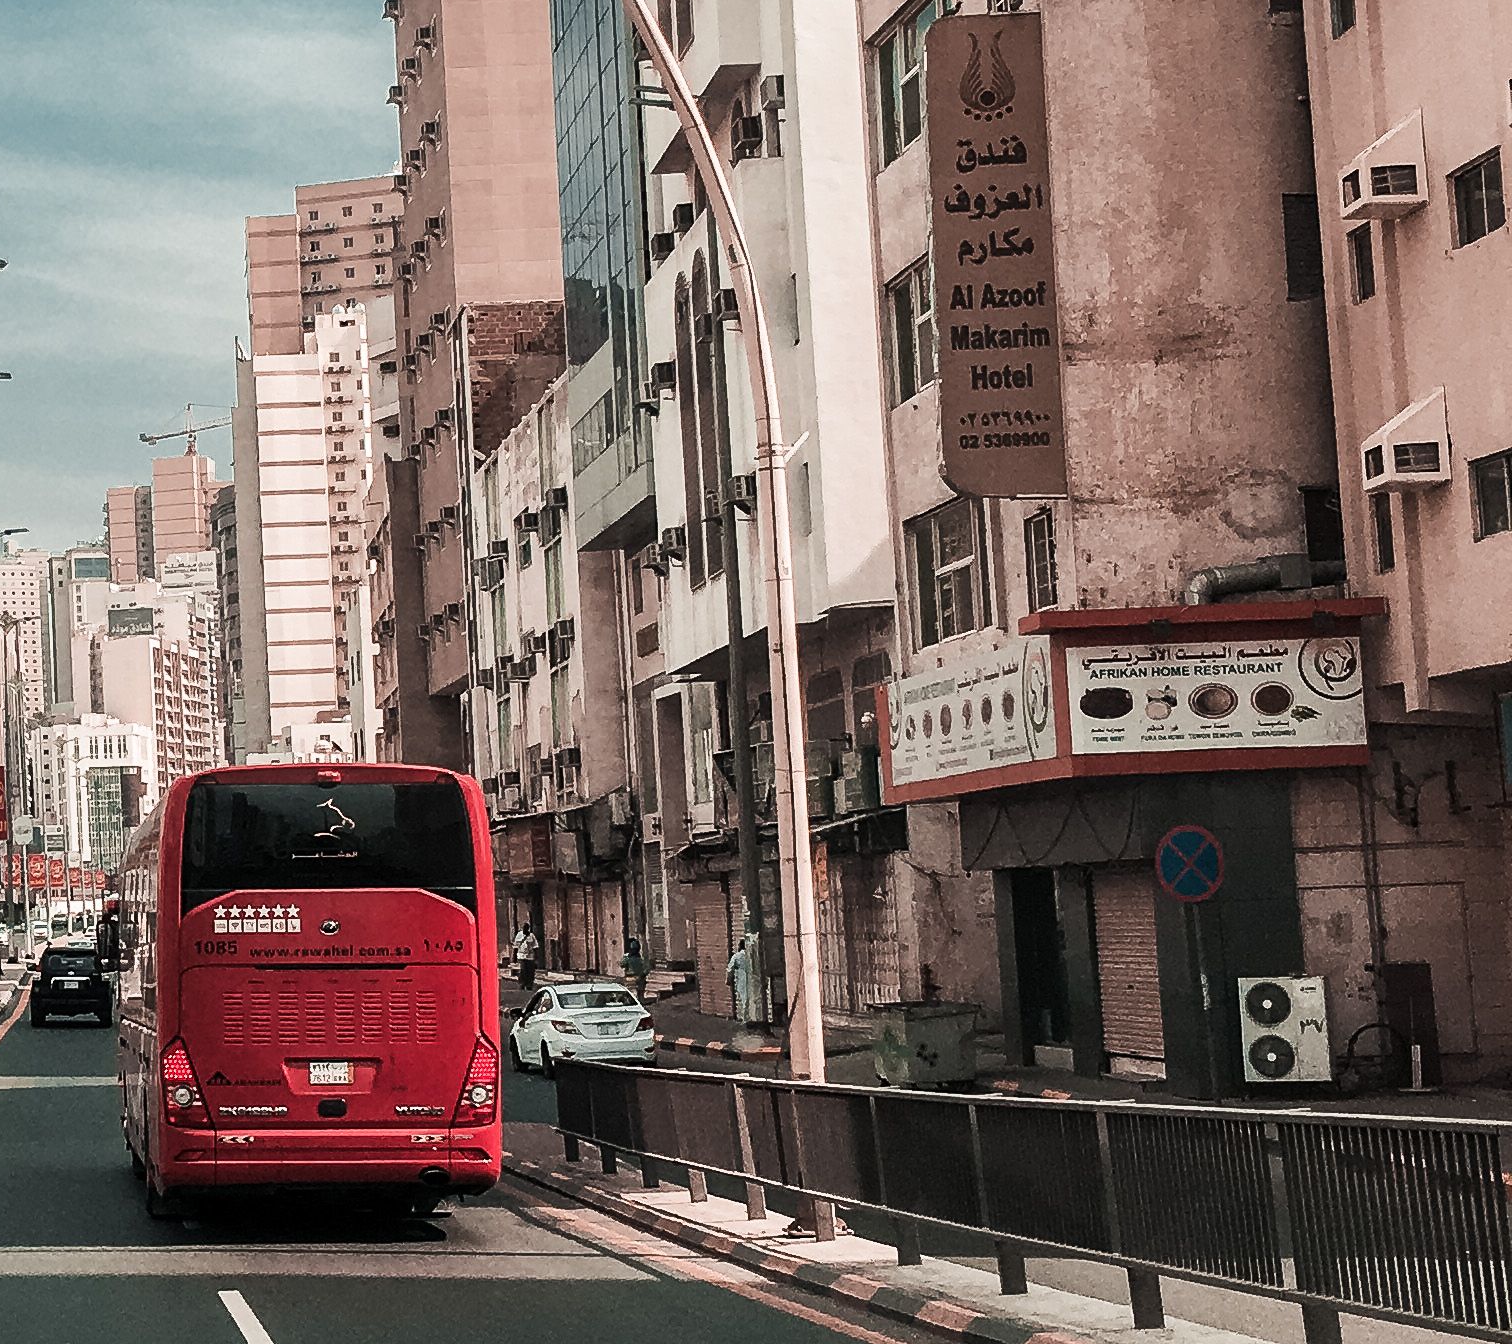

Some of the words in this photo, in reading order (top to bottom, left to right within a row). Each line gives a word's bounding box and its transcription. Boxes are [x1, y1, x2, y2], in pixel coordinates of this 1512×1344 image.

[955, 135, 1028, 174] فندق
[944, 183, 1044, 220] العزوف
[957, 226, 1035, 266] مكارم
[950, 284, 974, 310] Al
[980, 281, 1047, 310] Azoof
[950, 321, 1051, 351] Makarim
[970, 362, 1034, 391] Hotel
[959, 434, 980, 449] 02
[1175, 643, 1232, 664] البيت
[1237, 643, 1289, 662] مطعم
[1089, 666, 1148, 680] AFRIKAN
[1151, 665, 1191, 678] HOME
[1193, 661, 1284, 676] RESTAURANT
[193, 940, 238, 956] 1085
